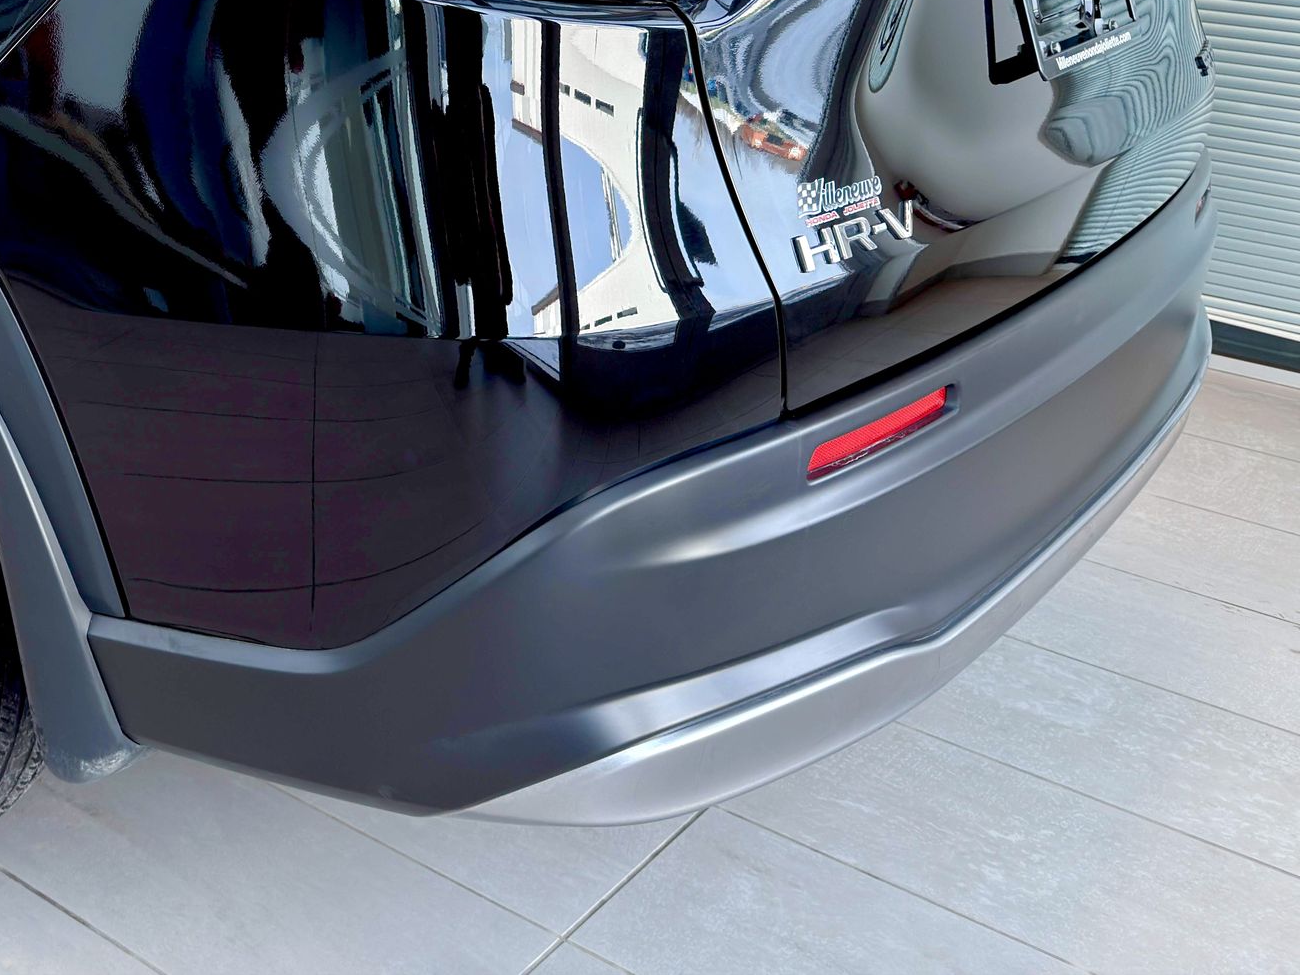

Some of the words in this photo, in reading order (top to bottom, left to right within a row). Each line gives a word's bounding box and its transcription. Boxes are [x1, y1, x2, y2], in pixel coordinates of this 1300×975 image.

[805, 210, 840, 227] HONDA
[842, 196, 880, 216] JOLIETTE
[810, 176, 883, 214] Villeneuve
[791, 199, 914, 274] HR-V
